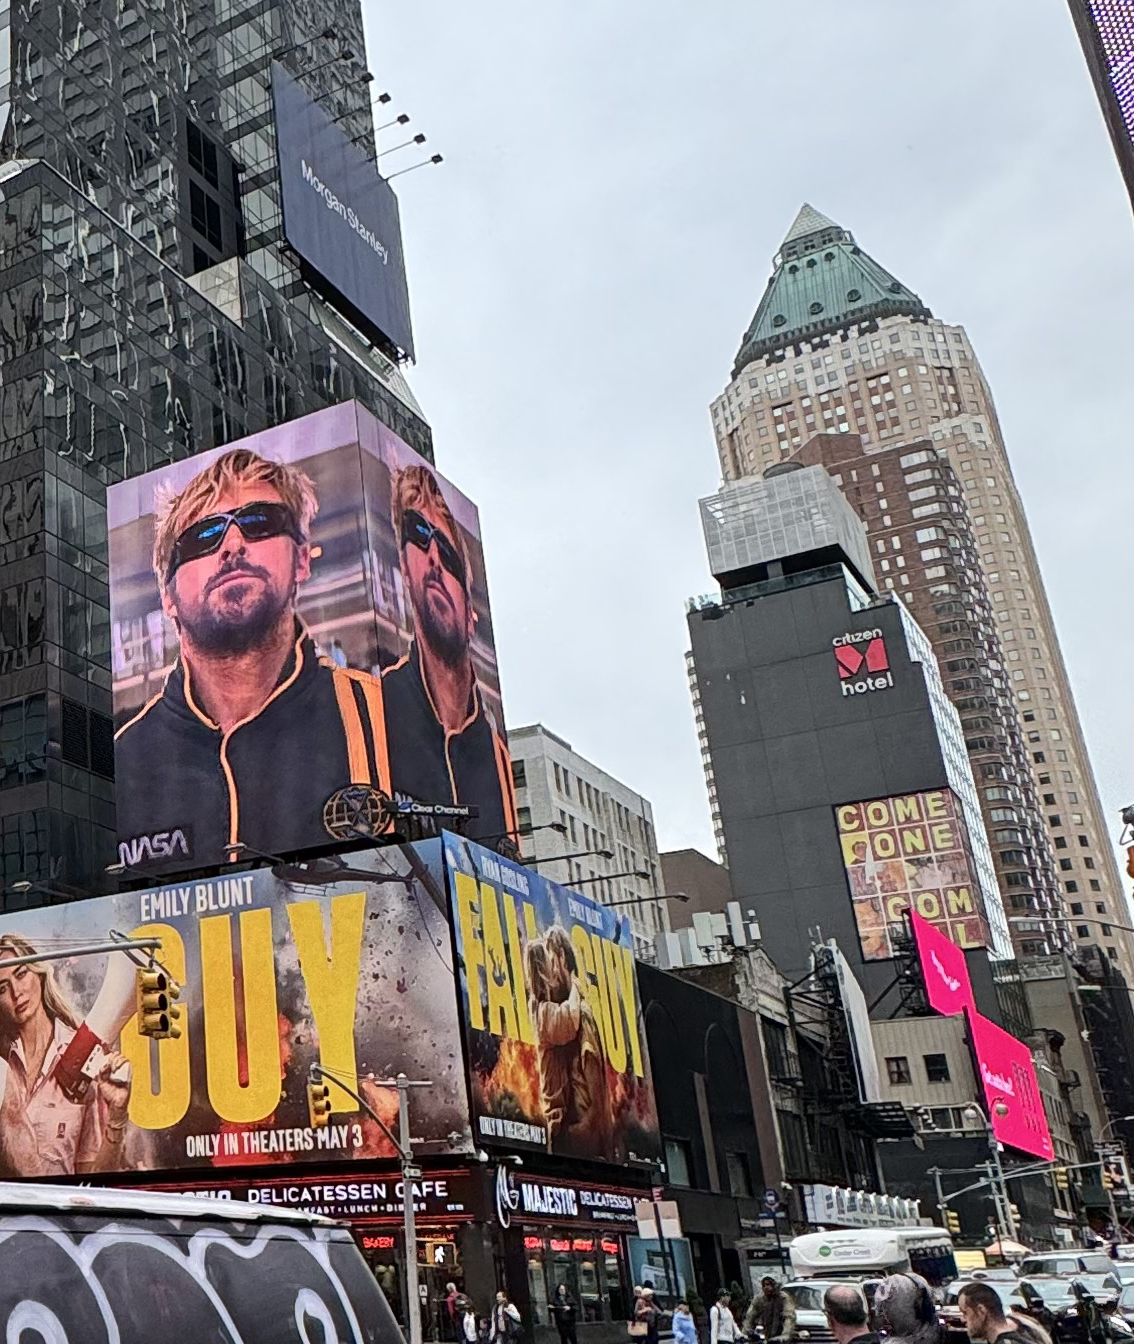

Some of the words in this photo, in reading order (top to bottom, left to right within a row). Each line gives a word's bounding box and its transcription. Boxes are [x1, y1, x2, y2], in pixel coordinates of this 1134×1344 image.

[301, 159, 347, 221] Morgan
[347, 207, 388, 265] Stanley
[832, 628, 883, 647] citizen
[840, 671, 894, 696] hotel
[411, 803, 432, 813] Clear
[434, 804, 469, 815] Channel
[838, 792, 948, 832] COME
[118, 829, 189, 867] NASA
[873, 826, 954, 859] ONE
[141, 886, 191, 922] EMILY
[195, 876, 254, 913] BLUNT
[120, 891, 366, 1130] GUY
[186, 1134, 219, 1157] ONLY
[223, 1132, 239, 1155] IN
[241, 1127, 314, 1155] THEATERS
[317, 1125, 348, 1150] MAY
[352, 1124, 363, 1148] 3
[248, 1182, 387, 1204] DELICATESSEN
[343, 1204, 378, 1213] LUNCH
[386, 1203, 427, 1213] DINER
[521, 1183, 579, 1216] MAJESTIC
